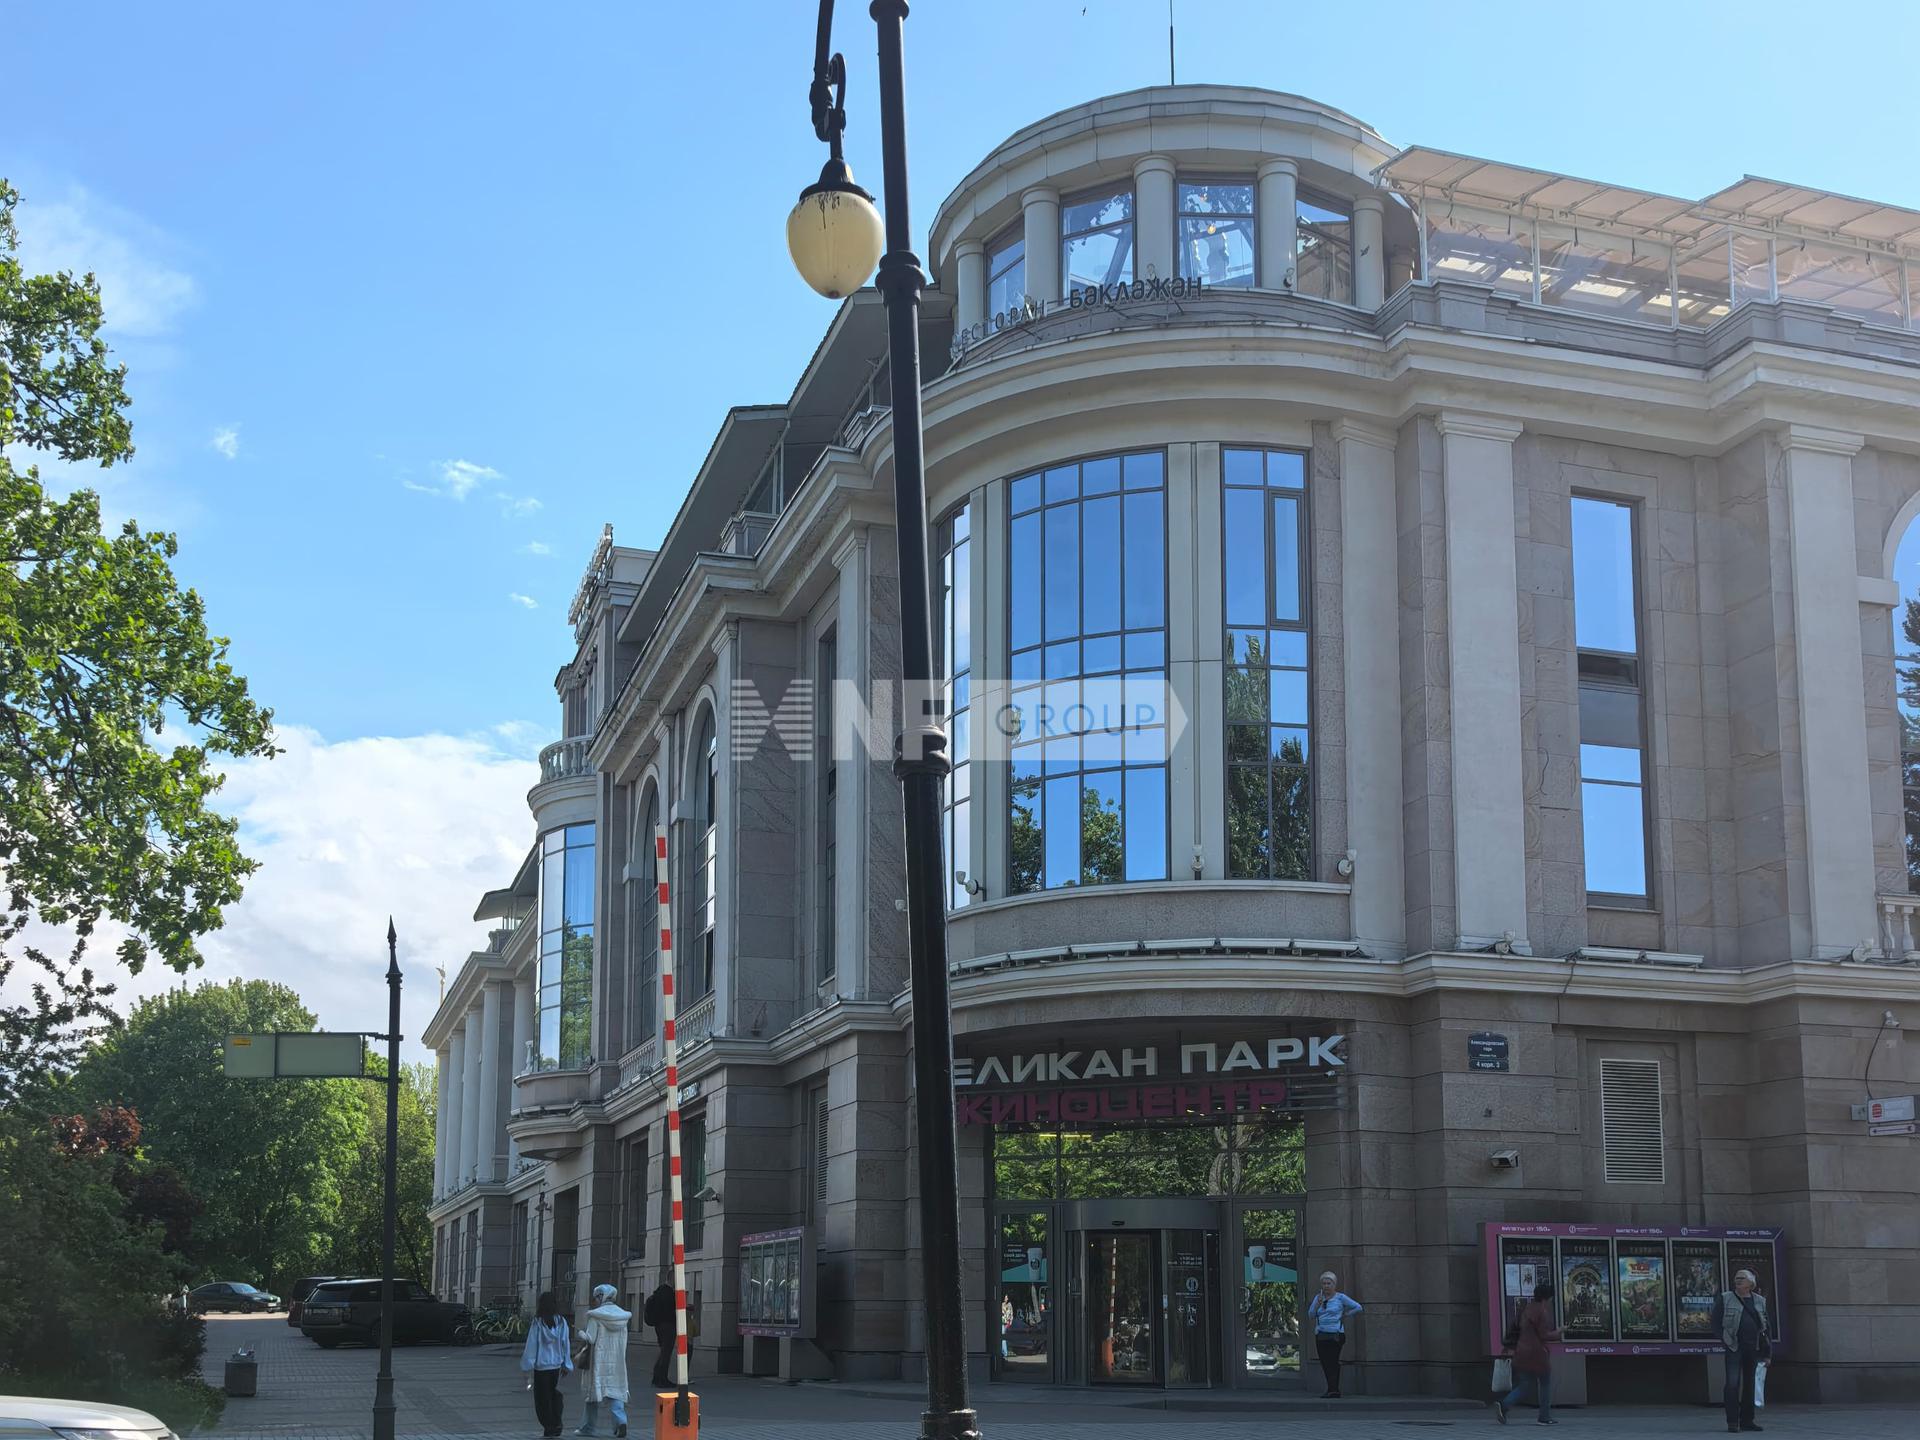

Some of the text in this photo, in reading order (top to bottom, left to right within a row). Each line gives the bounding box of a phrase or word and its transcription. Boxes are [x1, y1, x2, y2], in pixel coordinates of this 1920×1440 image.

[952, 1033, 1346, 1086] ЕЛИКАН ПАРК
[958, 1080, 1288, 1125] КИНОЦЕНТР
